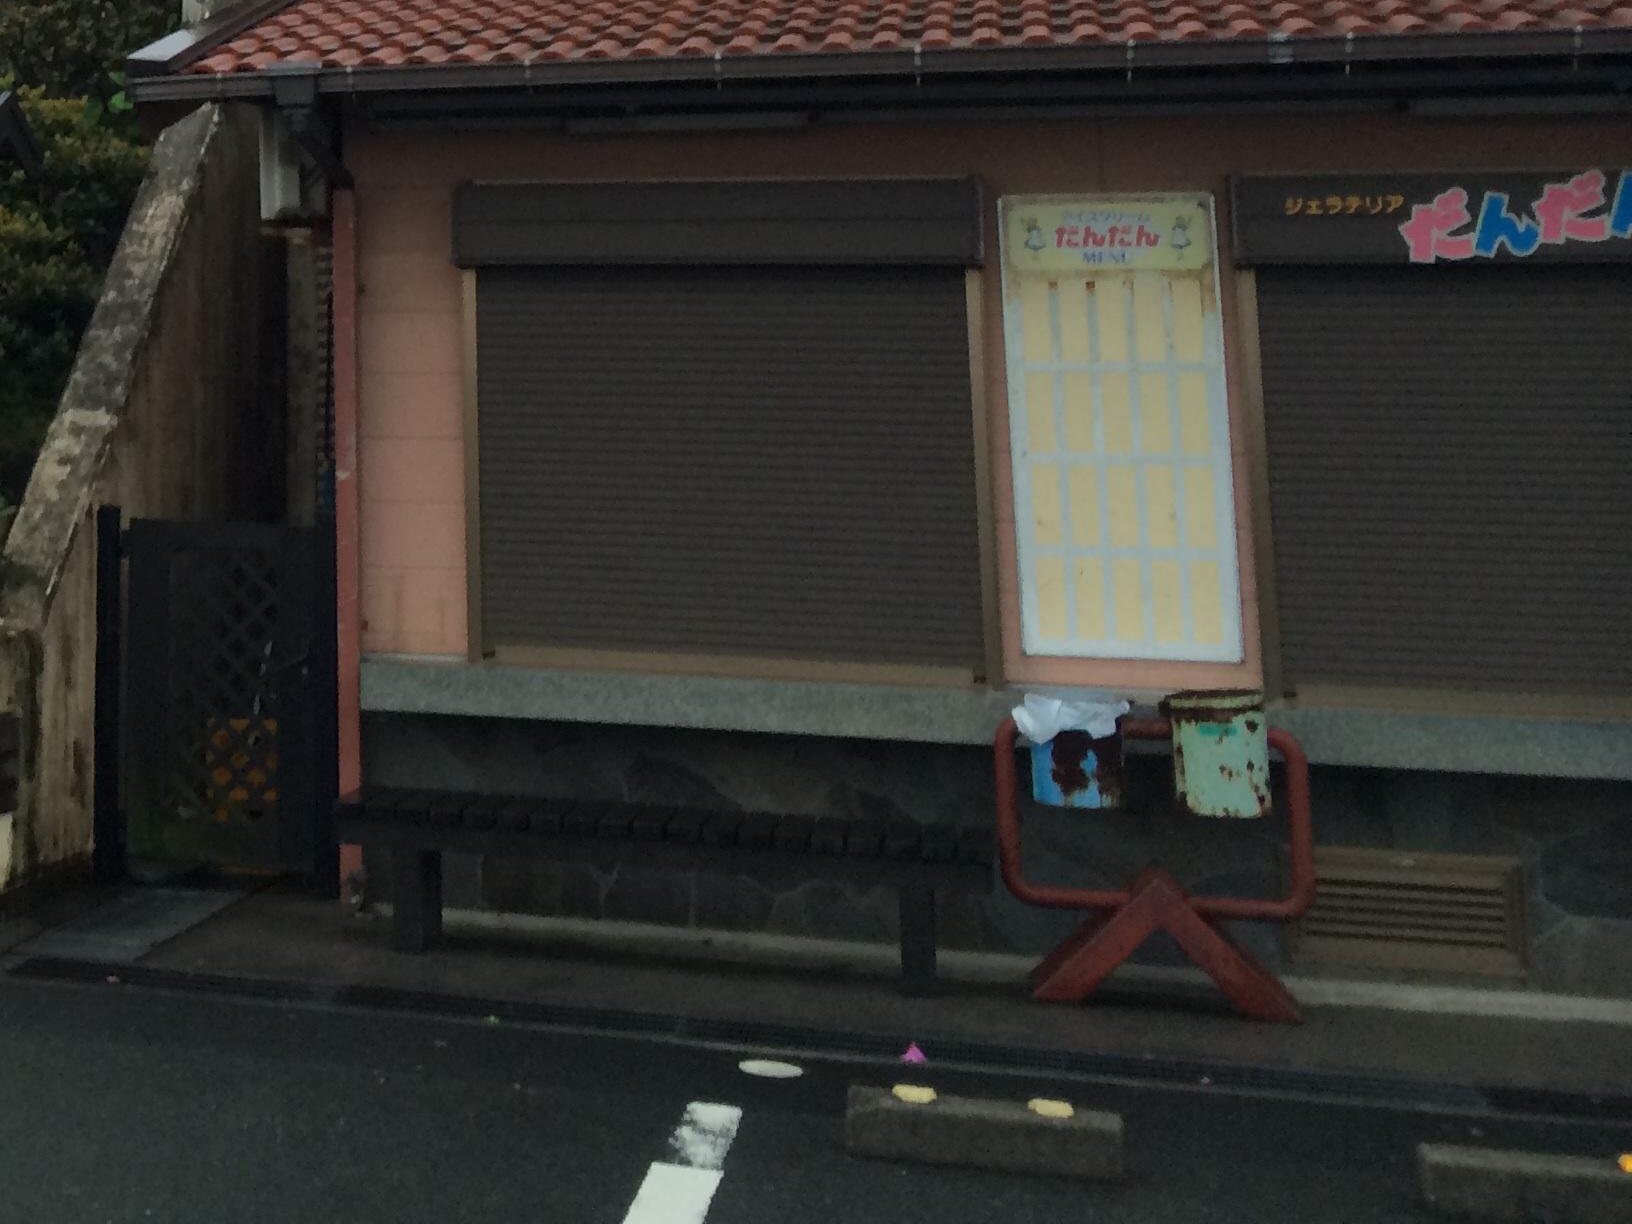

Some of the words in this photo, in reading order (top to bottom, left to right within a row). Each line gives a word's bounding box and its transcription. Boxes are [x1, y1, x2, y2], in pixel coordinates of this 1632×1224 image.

[1054, 225, 1162, 248] だんだん
[1284, 194, 1404, 216] ジェラテリア
[1398, 169, 1632, 264] だんだ
